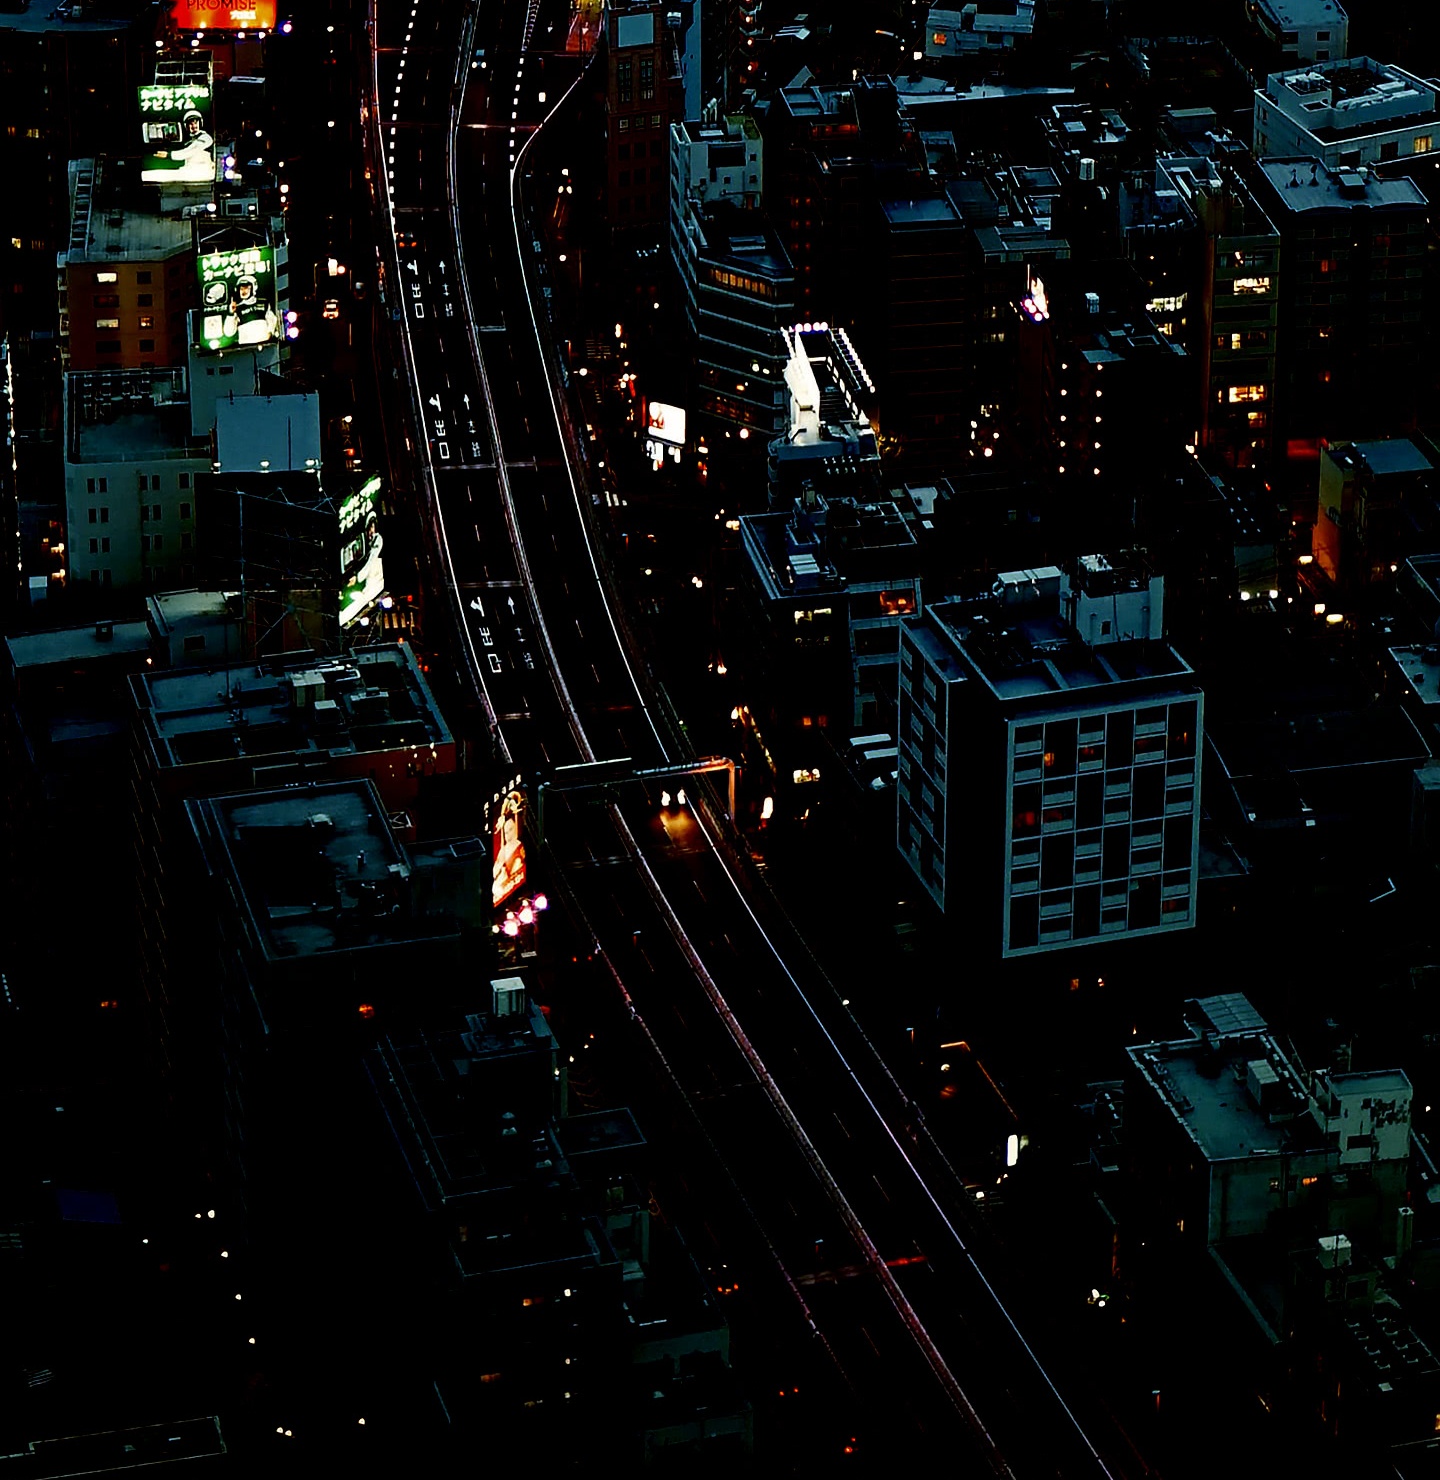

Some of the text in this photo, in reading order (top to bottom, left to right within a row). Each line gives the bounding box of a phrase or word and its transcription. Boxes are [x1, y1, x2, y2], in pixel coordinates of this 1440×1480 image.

[140, 98, 196, 111] ナビタイム
[202, 250, 261, 271] トラック
[203, 260, 271, 281] カーナビ!
